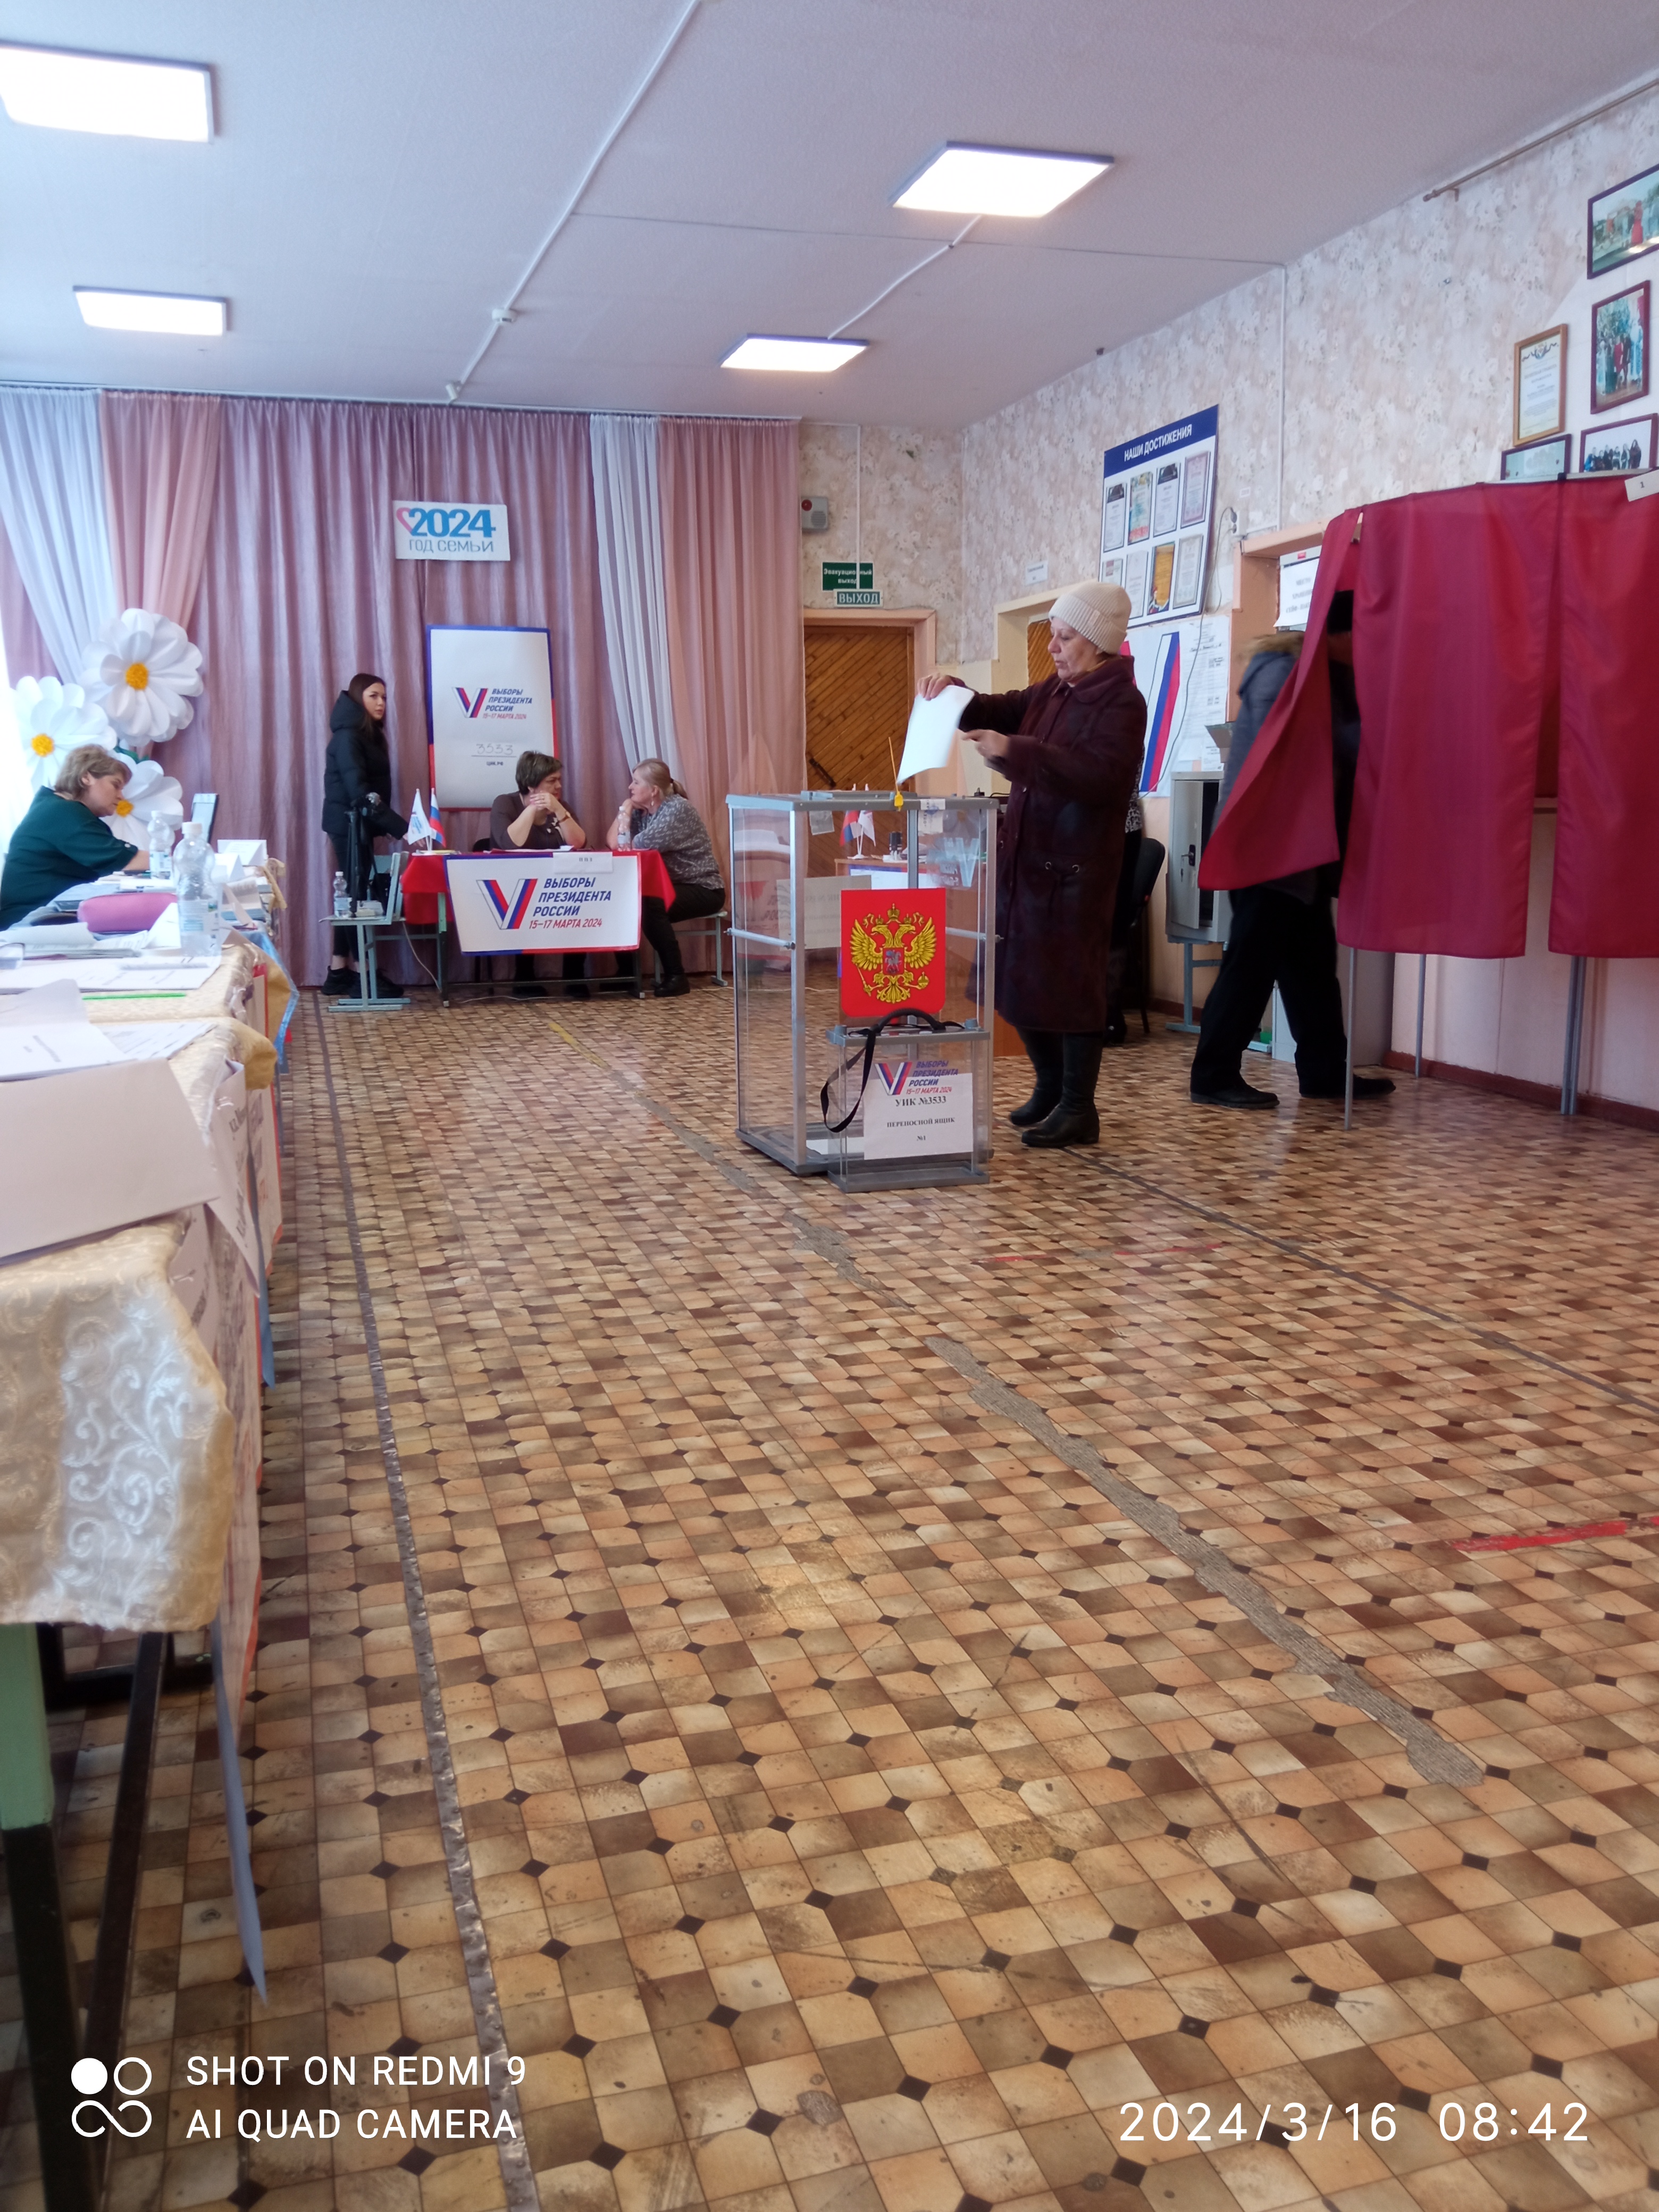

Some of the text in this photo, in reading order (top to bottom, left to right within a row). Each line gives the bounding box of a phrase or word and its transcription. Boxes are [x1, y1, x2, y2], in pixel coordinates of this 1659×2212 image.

[1124, 424, 1192, 462] НАШИ ДОСТИЖЕНИЯ
[409, 507, 496, 538] 2024
[839, 593, 878, 604] ВЫХОД
[543, 877, 596, 889] ВЫБОРЫ
[538, 891, 611, 903] ПРЕЗИДЕНТА
[533, 906, 581, 917] РОССИИ
[553, 919, 581, 928] МАРТА
[582, 918, 602, 927] 2024
[912, 1068, 958, 1077] ПРЕЗИДЕНТА
[895, 1096, 946, 1107] УИК №3533
[887, 1118, 933, 1127] ПЕРЕНОСНОЙ
